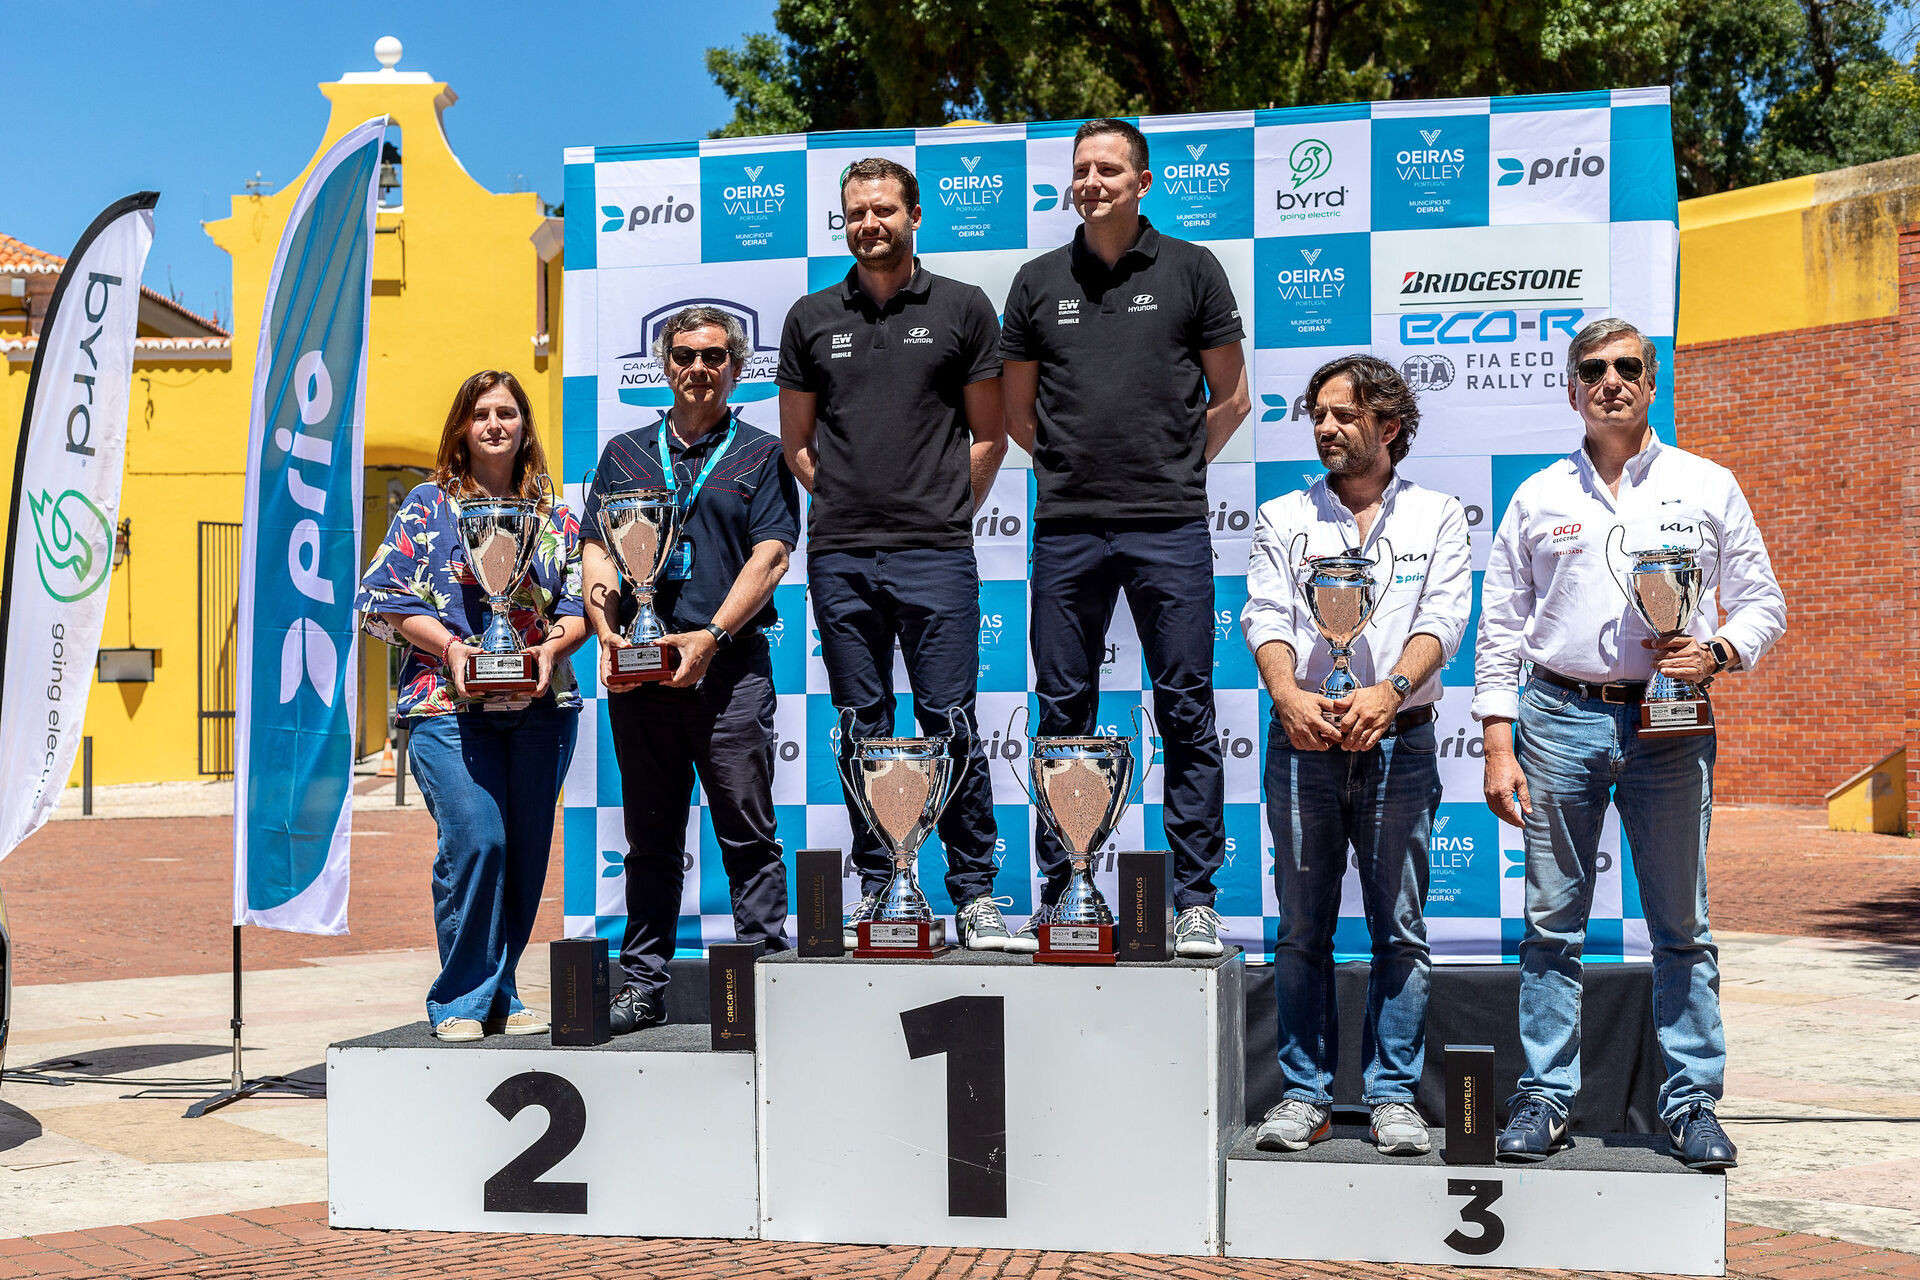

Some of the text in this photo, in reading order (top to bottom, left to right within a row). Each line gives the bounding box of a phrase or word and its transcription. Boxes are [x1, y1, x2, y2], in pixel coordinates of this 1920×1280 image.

[1397, 149, 1464, 164] OEIRAS
[1164, 162, 1230, 178] OEIRAS
[1396, 164, 1465, 180] VALLEY
[1528, 147, 1605, 186] prio
[939, 174, 1003, 190] OEIRAS
[1163, 178, 1230, 195] VALLEY
[723, 183, 785, 200] OEIRAS
[939, 190, 1003, 206] VALLEY
[1276, 186, 1346, 211] byrd
[628, 195, 695, 232] prio
[723, 199, 785, 216] VALLEY
[1183, 219, 1210, 227] OEIRAS
[1280, 210, 1341, 222] going electric
[958, 230, 984, 238] OEIRAS
[1278, 268, 1345, 283] OEIRAS
[1400, 269, 1583, 295] BRIDGESTONE
[1277, 283, 1345, 300] VALLEY
[1059, 299, 1080, 310] EW
[1128, 304, 1158, 312] HYUNDAI
[832, 333, 853, 344] EW
[66, 271, 122, 457] byrd
[1467, 352, 1554, 368] FIA ECO
[1467, 374, 1532, 390] RALLY
[275, 350, 337, 605] prio
[974, 507, 1021, 537] rio
[1553, 523, 1582, 536] acp
[1660, 522, 1693, 533] KIA
[1395, 553, 1428, 562] KIA
[47, 622, 65, 703] going
[1440, 727, 1485, 758] rio
[1430, 837, 1474, 851] IRAS
[1430, 853, 1474, 868] LLEY
[1136, 876, 1144, 934] CARCAVELOS
[900, 995, 1008, 1218] 1
[1464, 1076, 1472, 1134] CARCAVELOS
[484, 1071, 588, 1215] 2
[1443, 1178, 1505, 1256] 3
